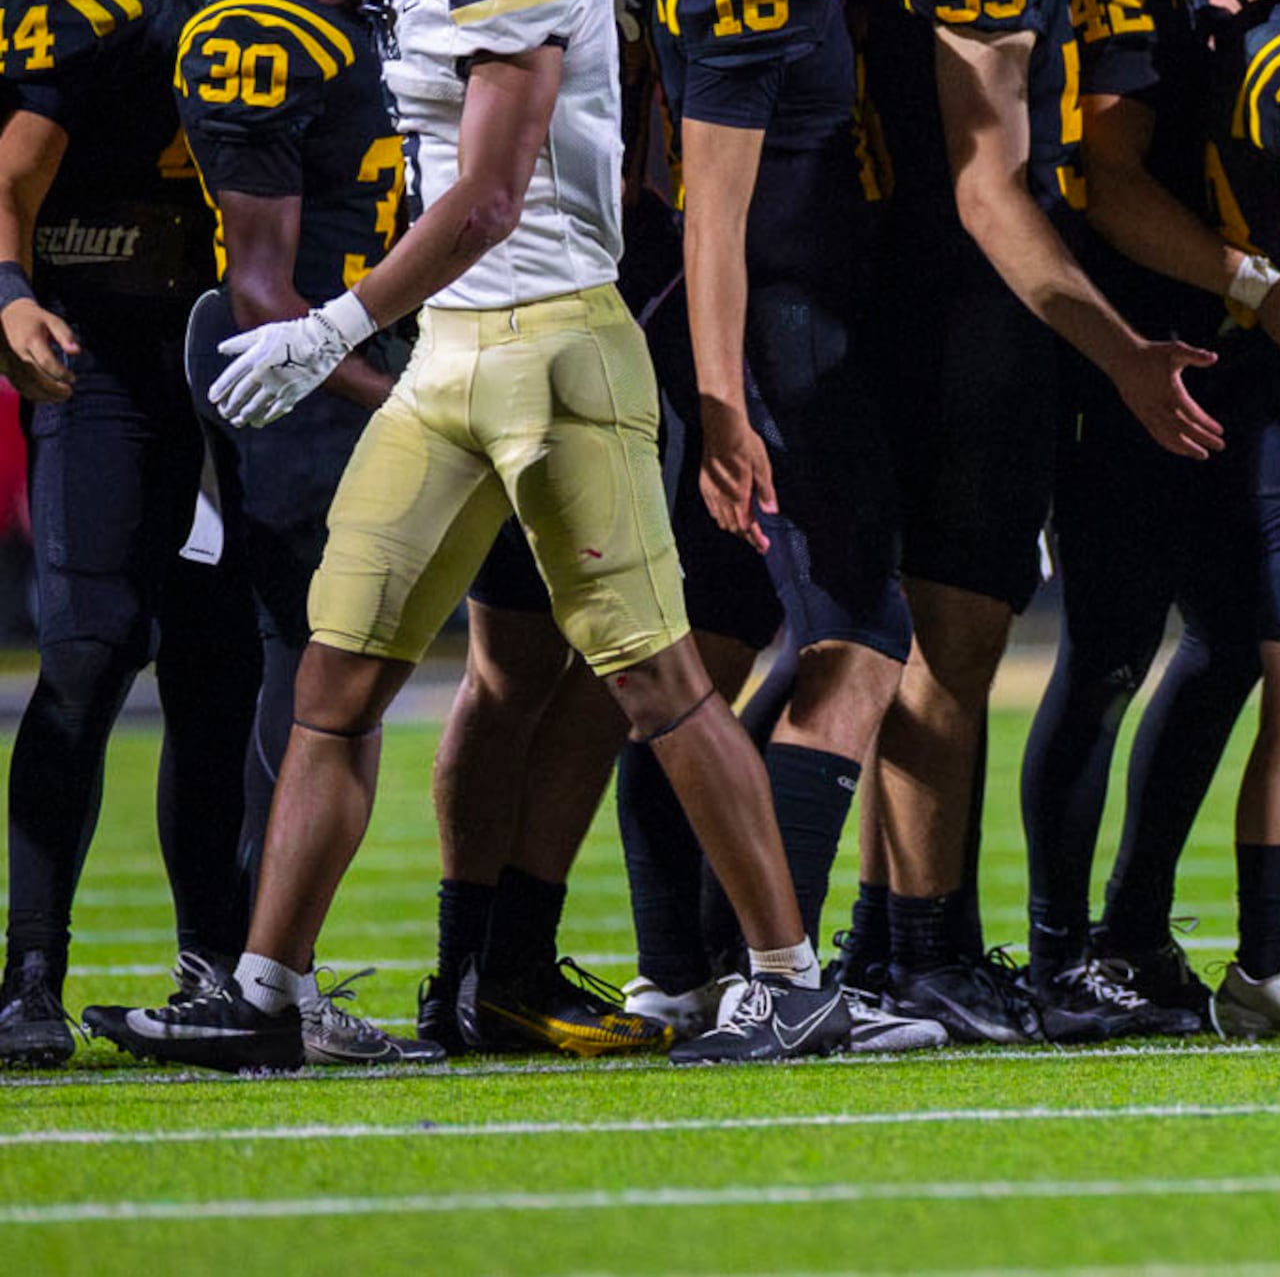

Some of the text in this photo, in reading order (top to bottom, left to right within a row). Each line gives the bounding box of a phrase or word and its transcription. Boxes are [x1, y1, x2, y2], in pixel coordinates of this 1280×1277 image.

[0, 5, 55, 72] 4
[198, 38, 288, 108] 30
[36, 218, 141, 257] schutt
